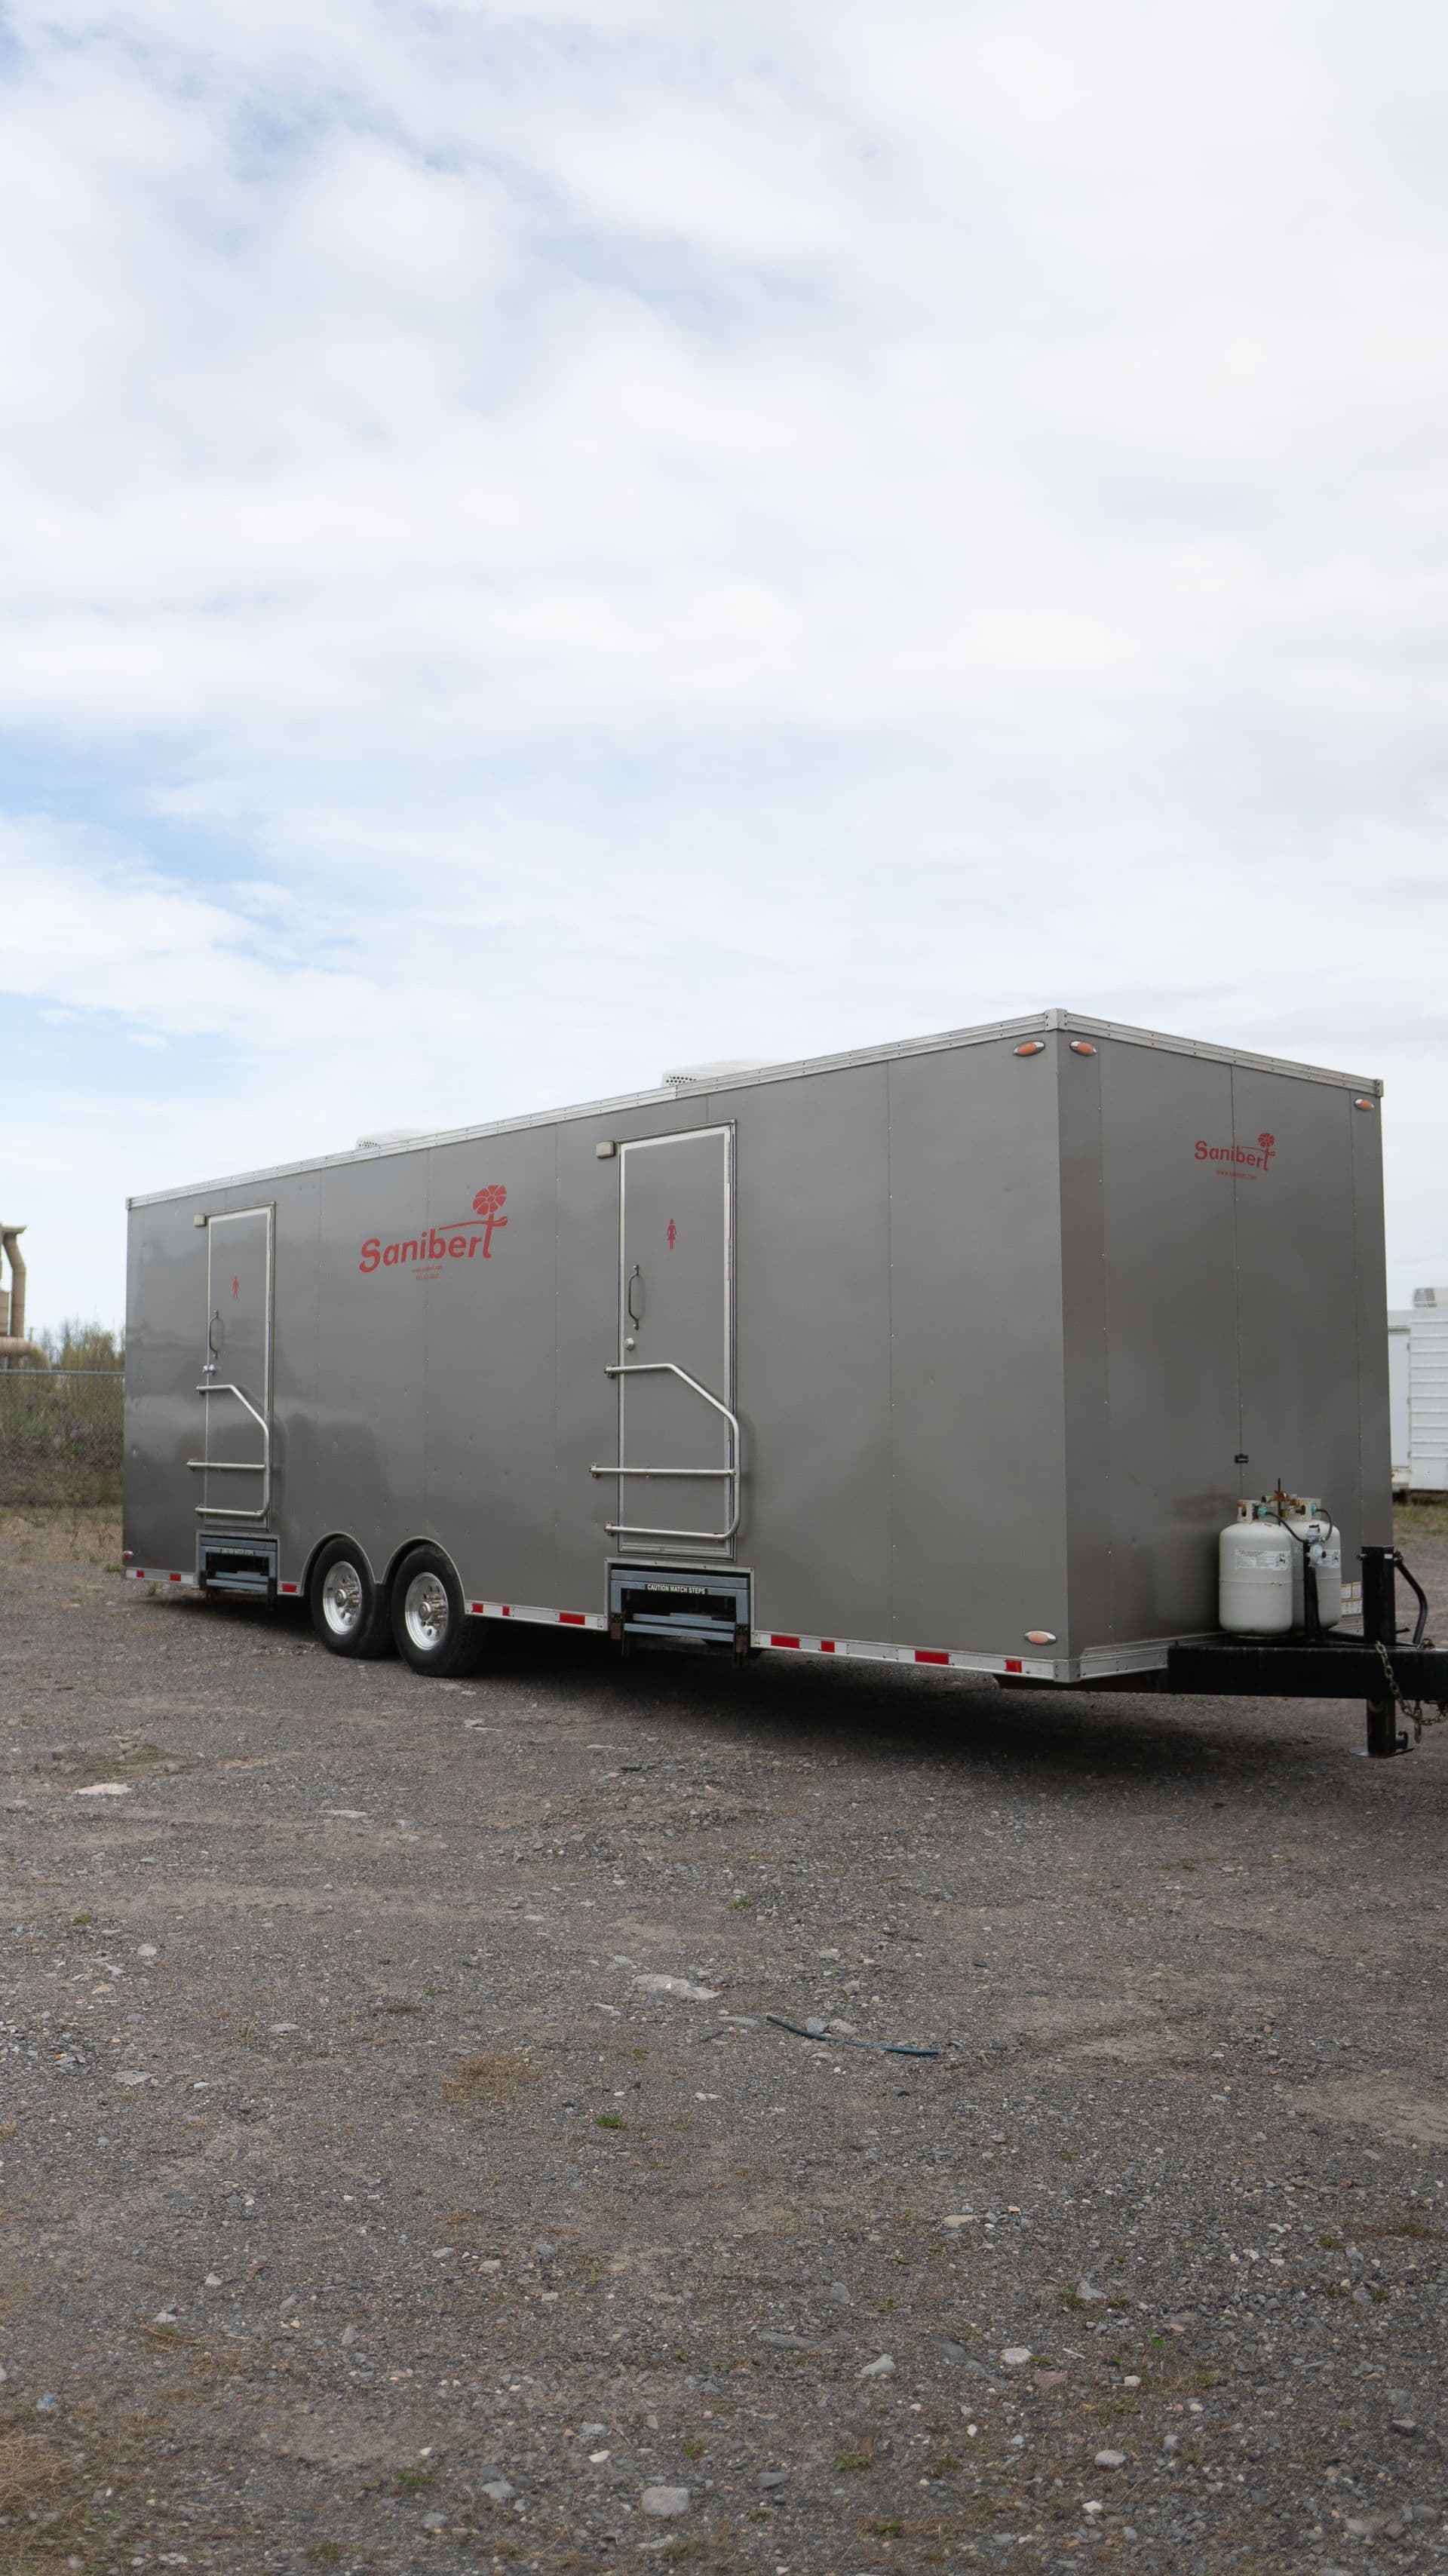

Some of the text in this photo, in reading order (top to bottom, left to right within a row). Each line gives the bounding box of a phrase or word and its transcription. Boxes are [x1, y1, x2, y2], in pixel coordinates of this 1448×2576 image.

[1194, 1139, 1275, 1171] Sanibert
[359, 1212, 508, 1273] Sanibert
[647, 1584, 706, 1595] CAUTION WATCH STEPS
